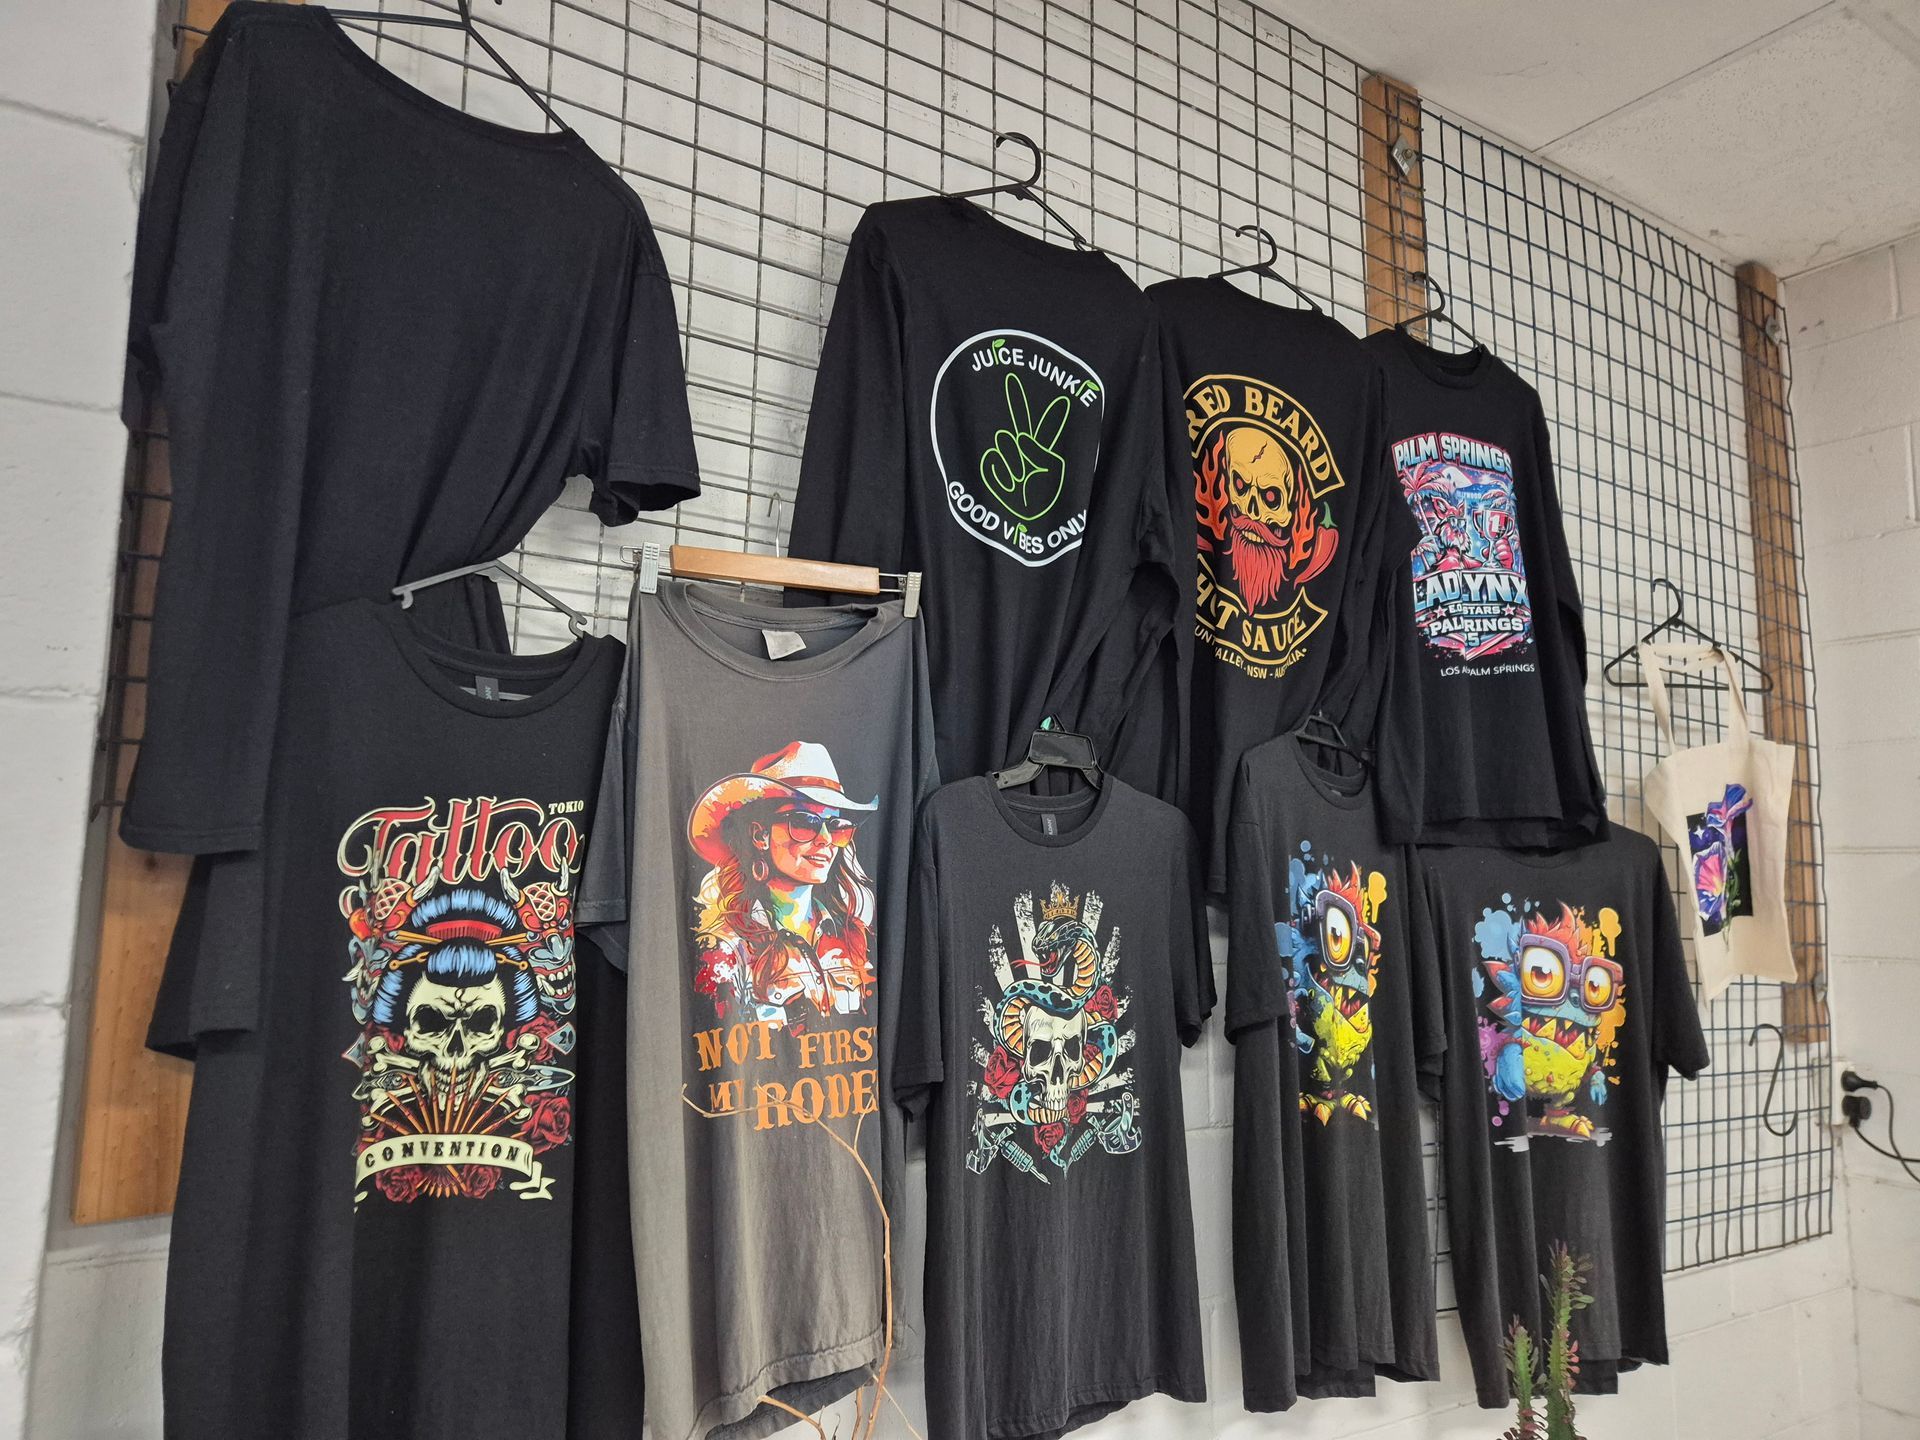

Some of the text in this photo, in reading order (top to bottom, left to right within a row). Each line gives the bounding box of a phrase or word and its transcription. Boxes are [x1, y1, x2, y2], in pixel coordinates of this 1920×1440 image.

[972, 339, 1100, 407] JUICE JUNKIE
[1186, 385, 1331, 481] RED BEARD
[1394, 435, 1513, 478] PALM SPRINGS
[949, 481, 1087, 554] GOOD VIBES ONLY
[1242, 606, 1307, 652] SAUCE
[1215, 647, 1245, 669] ALLEY
[1247, 665, 1268, 679] NSW
[1440, 666, 1461, 676] LOS
[1493, 663, 1535, 675] SPRINGS
[548, 800, 584, 815] TOKIO
[337, 796, 583, 886] Tattoo
[692, 1020, 879, 1072] NOT FIRS
[752, 1069, 879, 1131] RODE
[364, 1141, 521, 1168] CONVENTION
